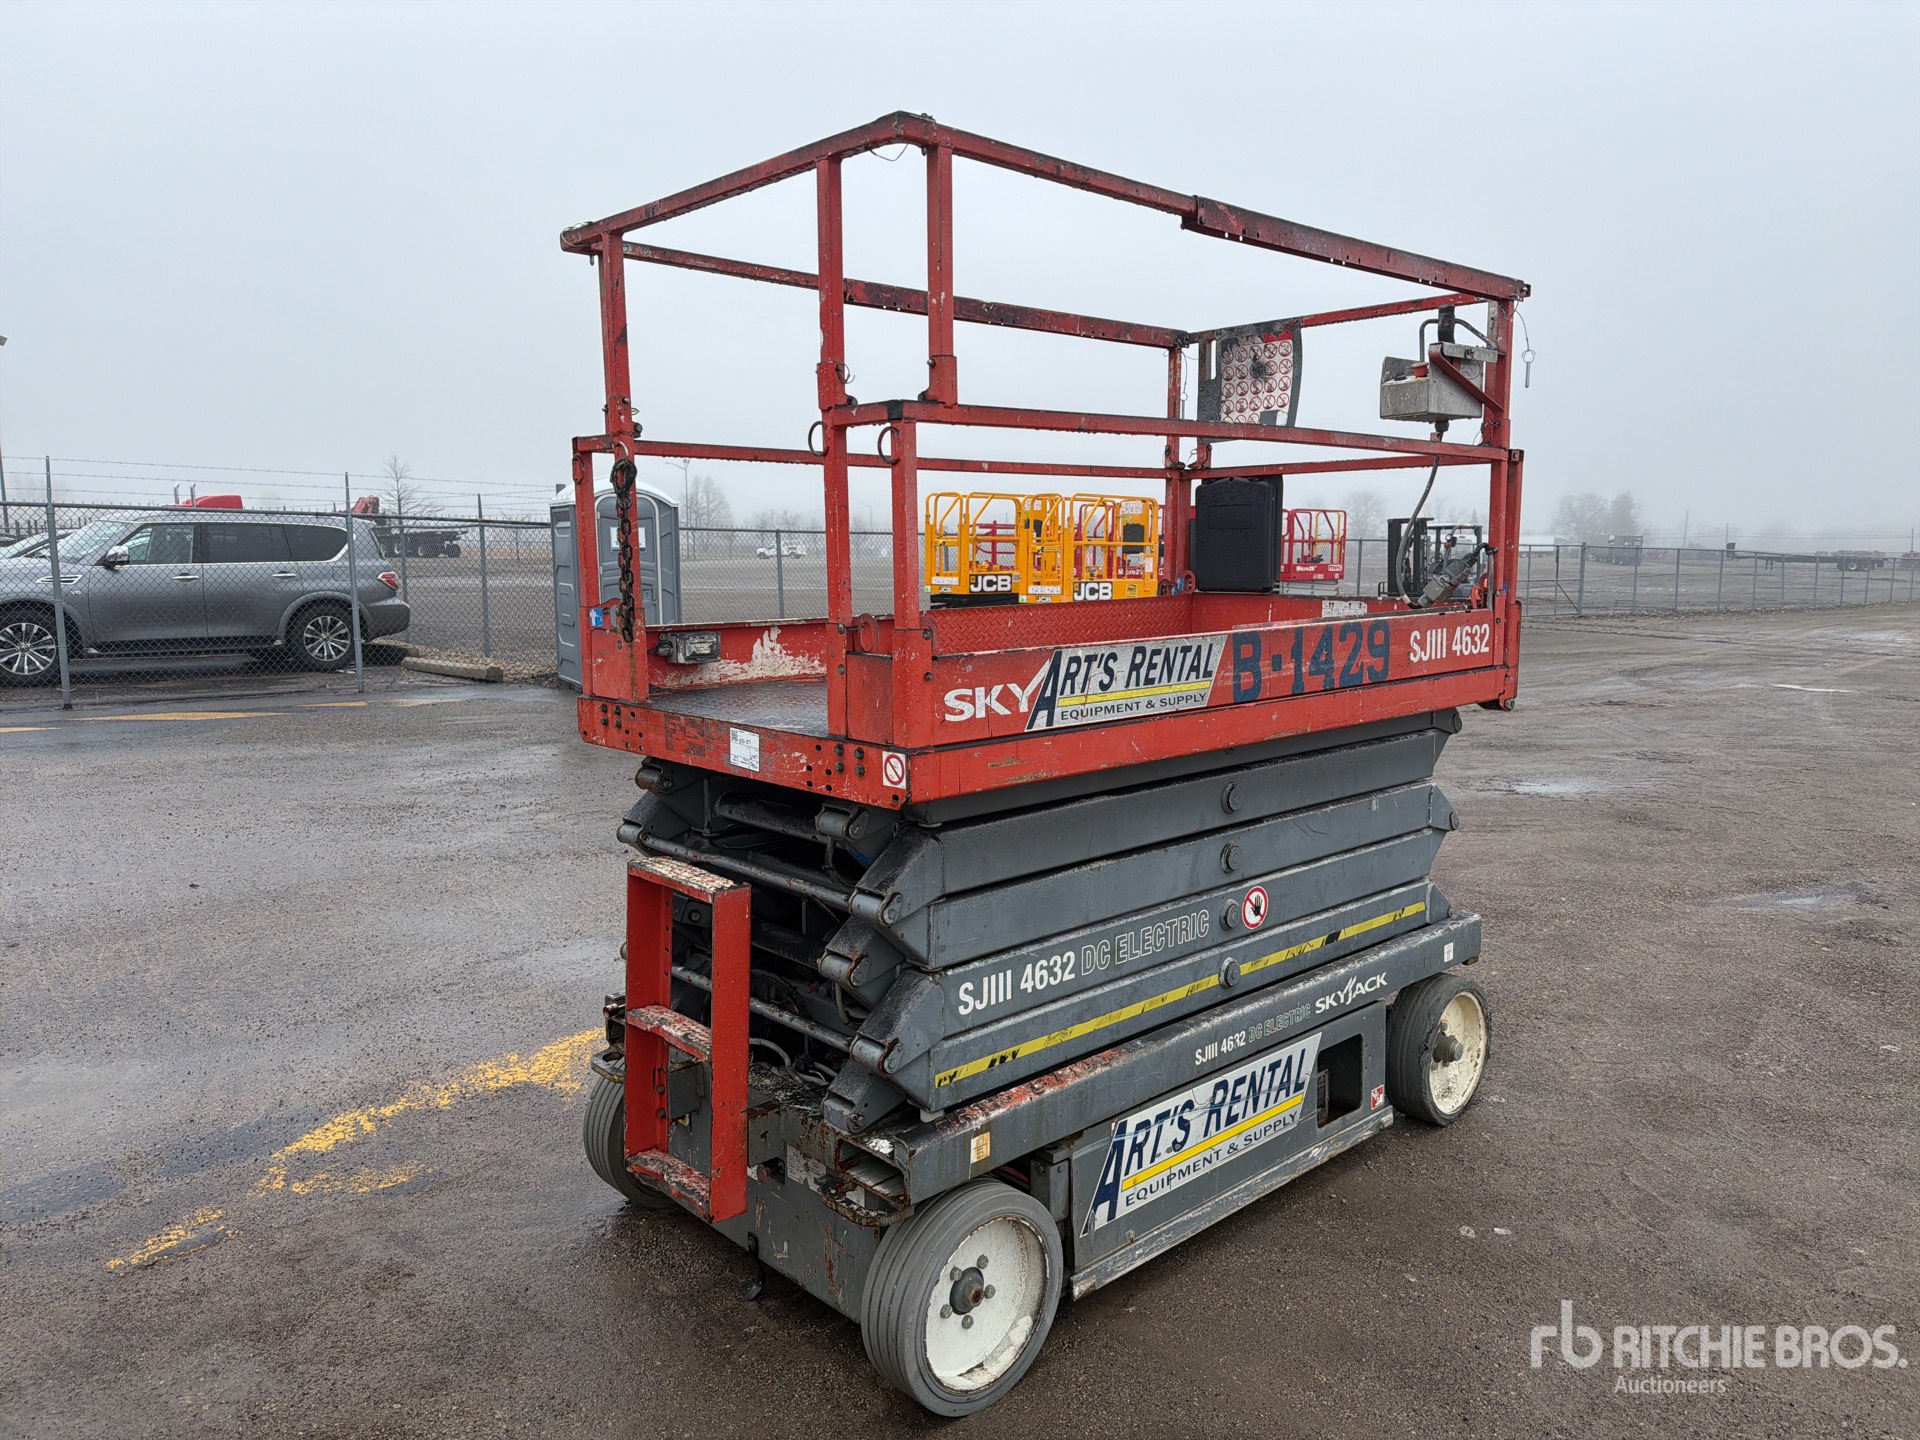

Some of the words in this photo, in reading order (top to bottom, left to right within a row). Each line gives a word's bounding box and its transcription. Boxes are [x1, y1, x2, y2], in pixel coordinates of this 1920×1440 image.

[970, 575, 1012, 592] JCB
[1073, 582, 1112, 601] JCB
[1409, 627, 1447, 663] SJIII
[1452, 623, 1490, 657] 4632
[1026, 650, 1118, 730] ART'S
[1125, 643, 1214, 689] RENTAL
[1060, 700, 1140, 721] EQUIPMENT
[1146, 699, 1156, 709] &
[1159, 692, 1207, 708] SUPPLY
[958, 969, 1012, 1016] SJIII
[1020, 951, 1076, 994] 4632
[1081, 939, 1111, 976] DC
[1114, 909, 1210, 965] ELECTRIC
[1220, 1031, 1247, 1054] 4632
[1248, 1024, 1263, 1043] DC
[1263, 1003, 1312, 1037] ELECTRIC
[1315, 971, 1388, 1014] SKYJACK
[1080, 1098, 1195, 1237] ART'S
[1203, 1048, 1307, 1139] RENTAL
[1125, 1148, 1222, 1207] EQUIPMENT
[1227, 1142, 1239, 1155] &
[1243, 1111, 1298, 1147] SUPPLY
